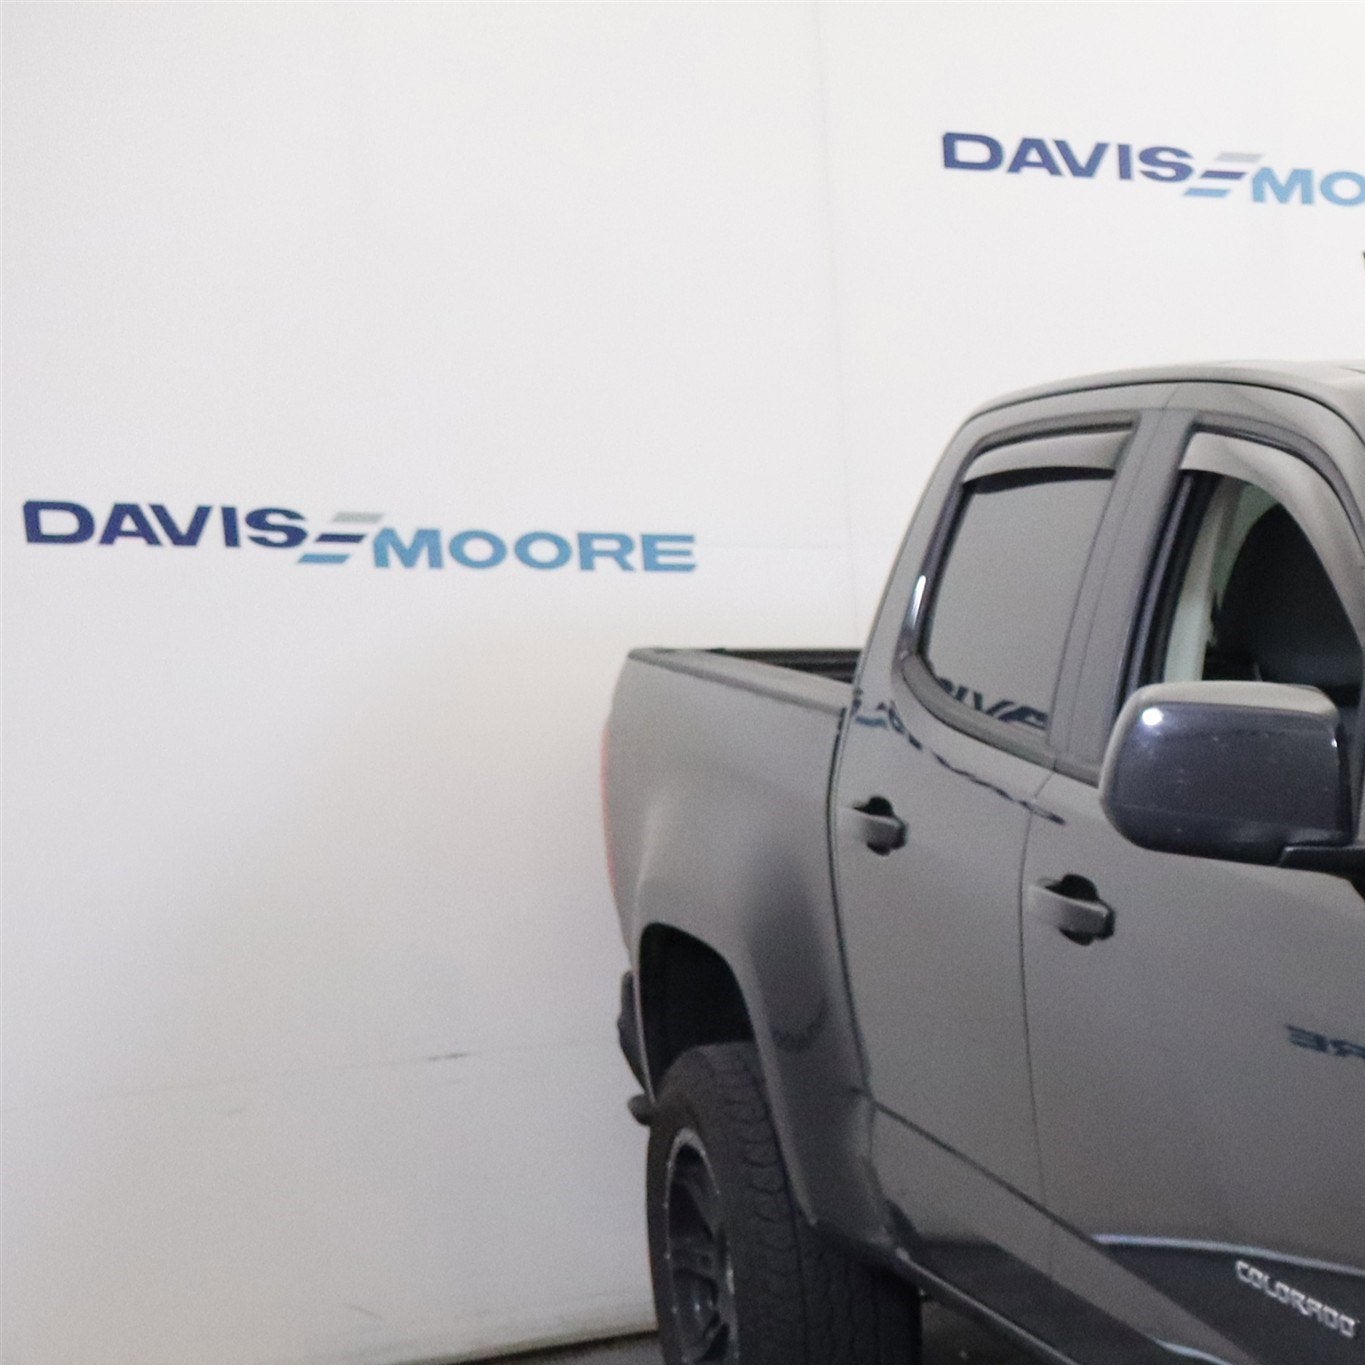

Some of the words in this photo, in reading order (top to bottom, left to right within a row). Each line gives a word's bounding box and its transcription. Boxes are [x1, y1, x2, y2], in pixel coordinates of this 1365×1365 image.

[941, 131, 1195, 184] DAVIS
[22, 499, 308, 550] DAVIS
[372, 526, 697, 573] MOORE
[1236, 1259, 1355, 1338] COLORADO
